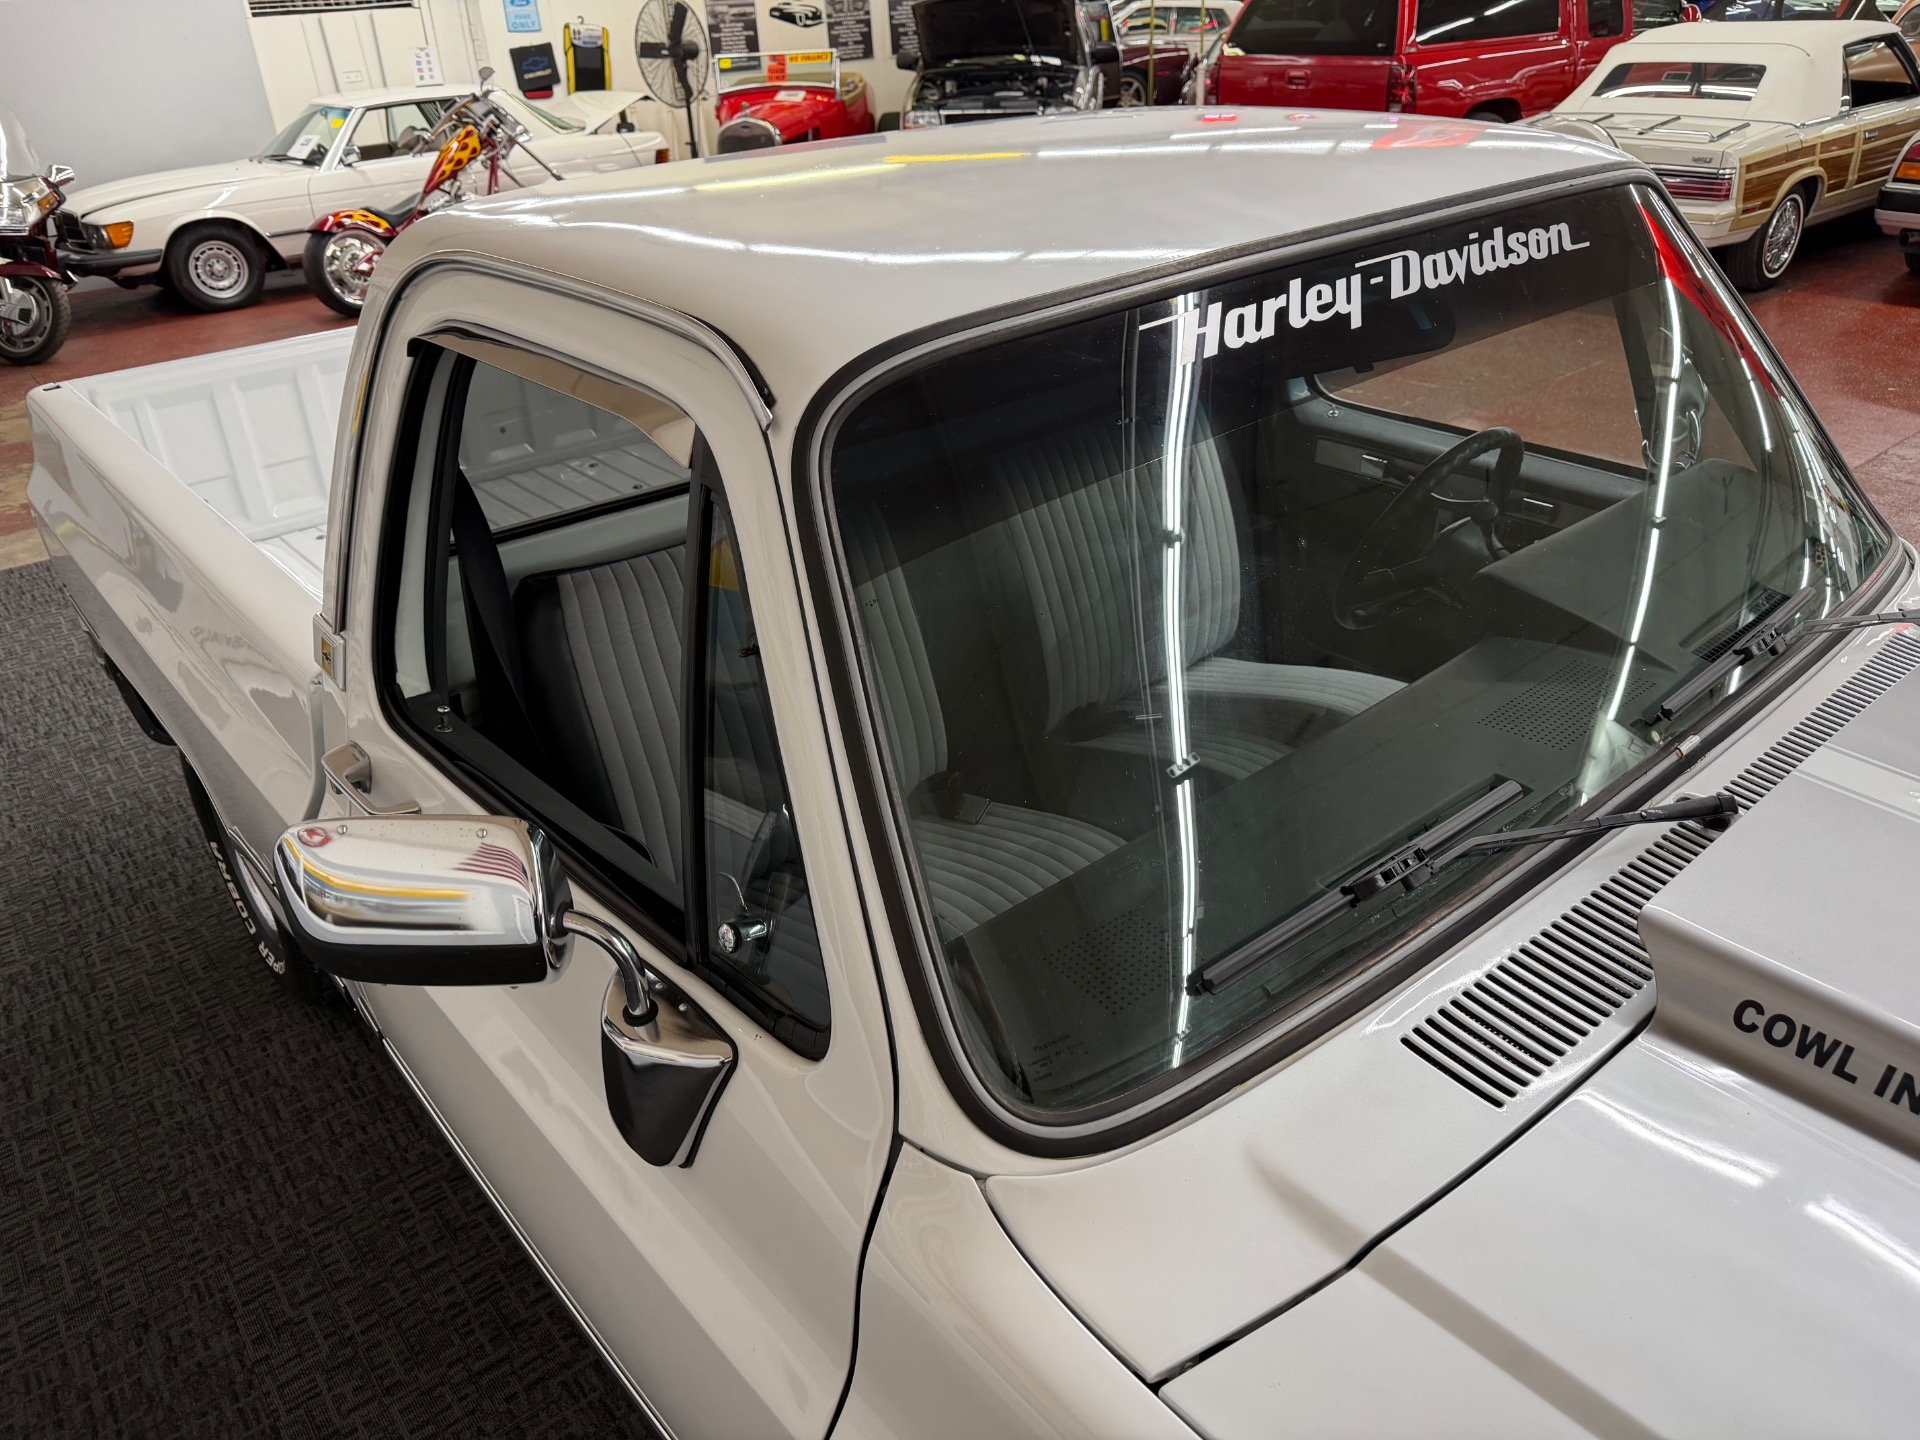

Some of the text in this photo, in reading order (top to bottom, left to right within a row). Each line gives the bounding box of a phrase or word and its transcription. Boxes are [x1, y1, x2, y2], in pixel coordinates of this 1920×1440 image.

[1139, 222, 1590, 366] Harley-Davidson
[209, 841, 257, 936] COBRA
[1733, 999, 1920, 1116] COWL IN
